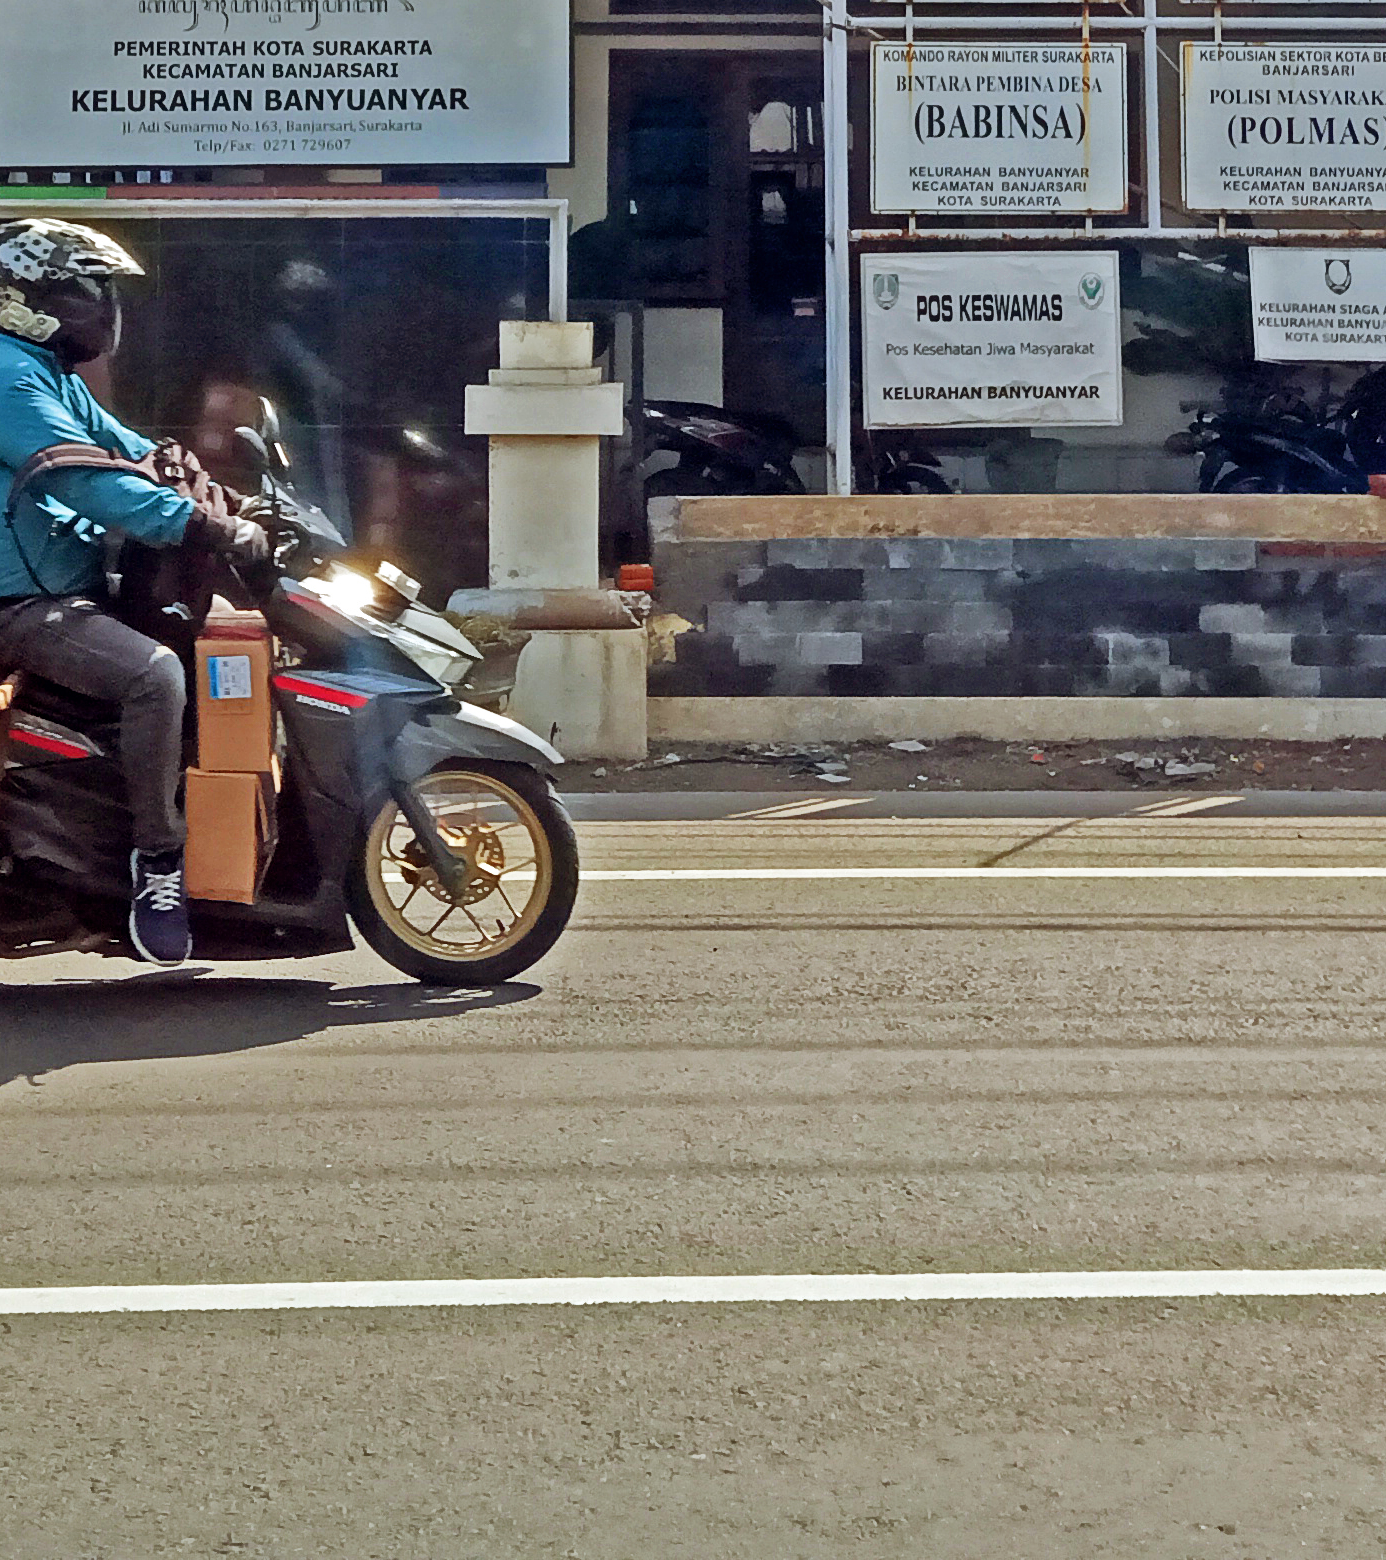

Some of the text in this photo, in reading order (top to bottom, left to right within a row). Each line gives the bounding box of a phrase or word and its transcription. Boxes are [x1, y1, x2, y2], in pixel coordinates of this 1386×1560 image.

[113, 39, 433, 57] PEMERINTAH KOTA SURAKARTA
[1199, 48, 1276, 62] KEPOLISIAN
[1279, 50, 1332, 63] SEKTOR
[1335, 50, 1370, 63] KOTA
[883, 49, 1115, 66] KOMANDO RAYON MILITER SURAKARTA
[142, 62, 399, 80] KECAMATAN BANJARSARI
[1262, 64, 1355, 77] BANJARSARI
[896, 74, 1103, 94] BINTARA PEMBINA DESA
[71, 87, 470, 113] KELURAHAN BANYUANYAR
[1210, 88, 1271, 105] POLISI
[137, 121, 161, 134] Adi
[163, 120, 228, 134] Sumarmo
[285, 119, 357, 135] Banjarsari,
[358, 119, 424, 132] Surakarta
[914, 101, 1086, 146] (BABINSA)
[263, 138, 296, 152] 0271
[301, 138, 352, 152] 729607
[909, 166, 1090, 178] KELURAHAN BANYUANYAR
[1219, 165, 1302, 178] KELURAHAN
[912, 180, 1087, 193] KECAMATAN BANJARSARI
[1223, 180, 1305, 192] KECAMATAN
[937, 195, 1062, 207] KOTA SURAKARTA
[1248, 194, 1373, 207] KOTA SURAKARTA
[916, 293, 1063, 323] POS KESWAMAS
[1259, 302, 1337, 315] KELURAHAN
[1339, 303, 1380, 316] SIAGA
[1257, 316, 1334, 329] KELURAHAN
[1284, 331, 1319, 343] KOTA
[885, 341, 1095, 358] Pos Kesehatan Jiwa Masyarakat
[882, 385, 1101, 401] KELURAHAN BANYUANYAR
